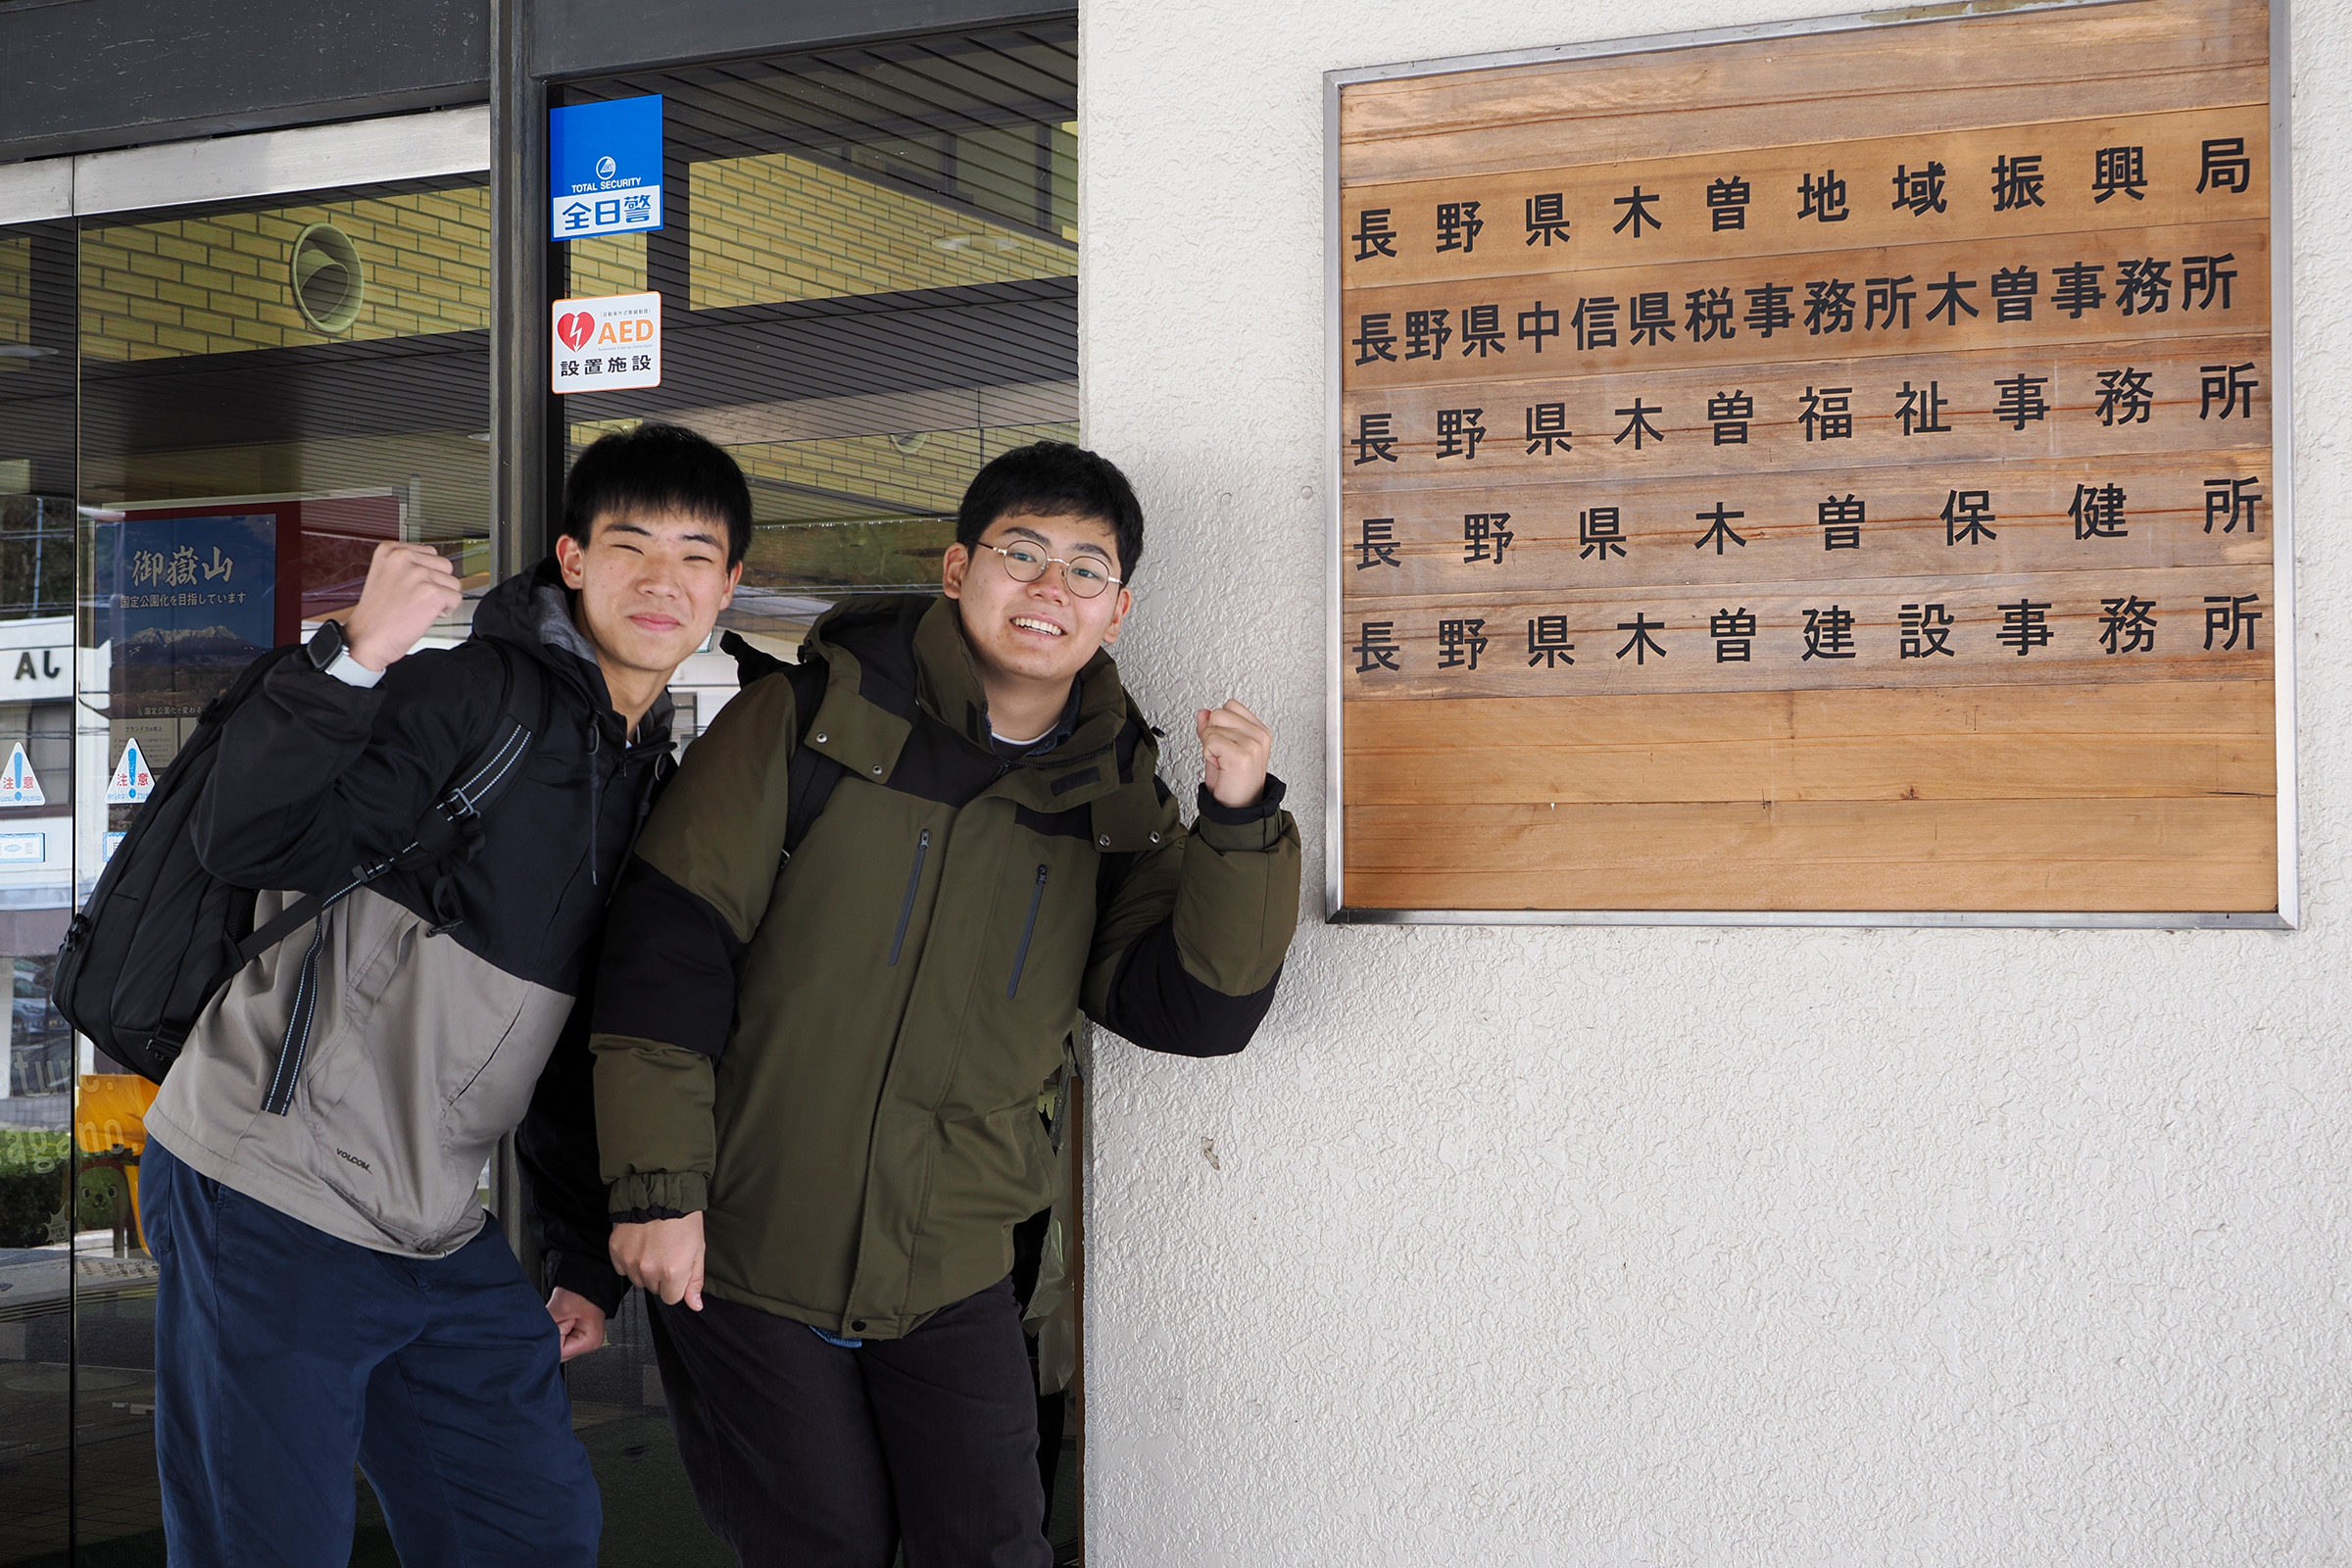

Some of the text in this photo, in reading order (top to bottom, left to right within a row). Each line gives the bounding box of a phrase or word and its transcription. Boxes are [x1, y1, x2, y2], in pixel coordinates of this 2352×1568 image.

[571, 177, 642, 193] TOTAL SECURITY
[1351, 137, 2252, 263] 長野県木曽地域振興局
[562, 194, 652, 230] 全日警
[1351, 252, 2239, 368] 長野県中信県税事務所木曽事務所
[597, 318, 654, 345] AED
[560, 355, 652, 377] 設置施設
[1350, 361, 2259, 466] 長野県木曽福祉事務所
[1352, 475, 2263, 571] 長野県木曽保健所
[131, 545, 234, 588] 御嶽山
[120, 592, 247, 609] 国定公園化を目指しています
[1351, 592, 2263, 674] 長野県木曽建設事務所
[3, 776, 34, 790] 注意
[117, 772, 149, 786] 注意
